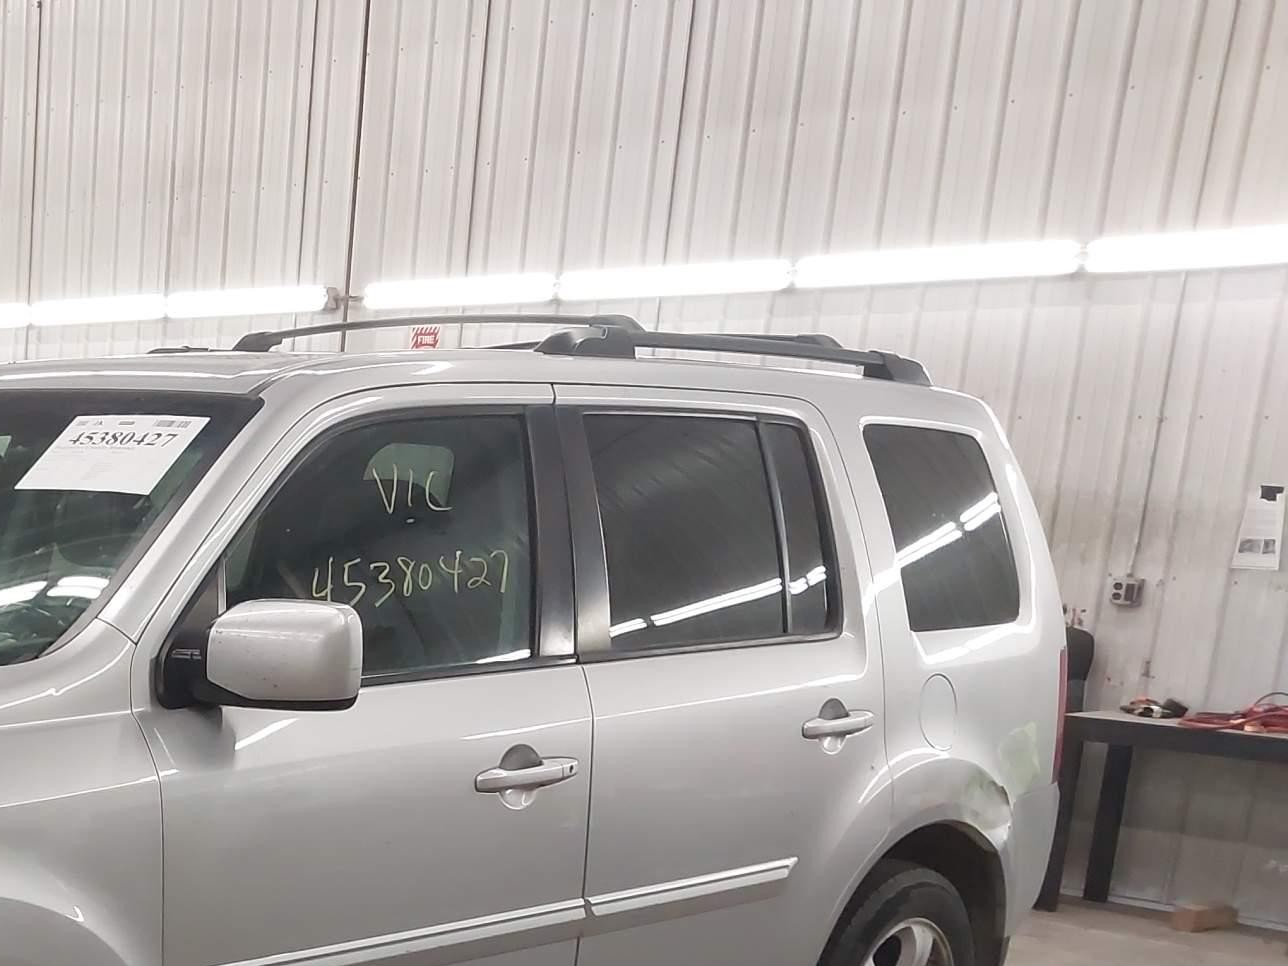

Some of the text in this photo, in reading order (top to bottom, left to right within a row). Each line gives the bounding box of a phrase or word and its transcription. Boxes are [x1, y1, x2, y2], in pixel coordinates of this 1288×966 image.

[417, 335, 435, 345] FIRE
[68, 431, 179, 447] 45380427
[311, 550, 509, 607] 45380427
